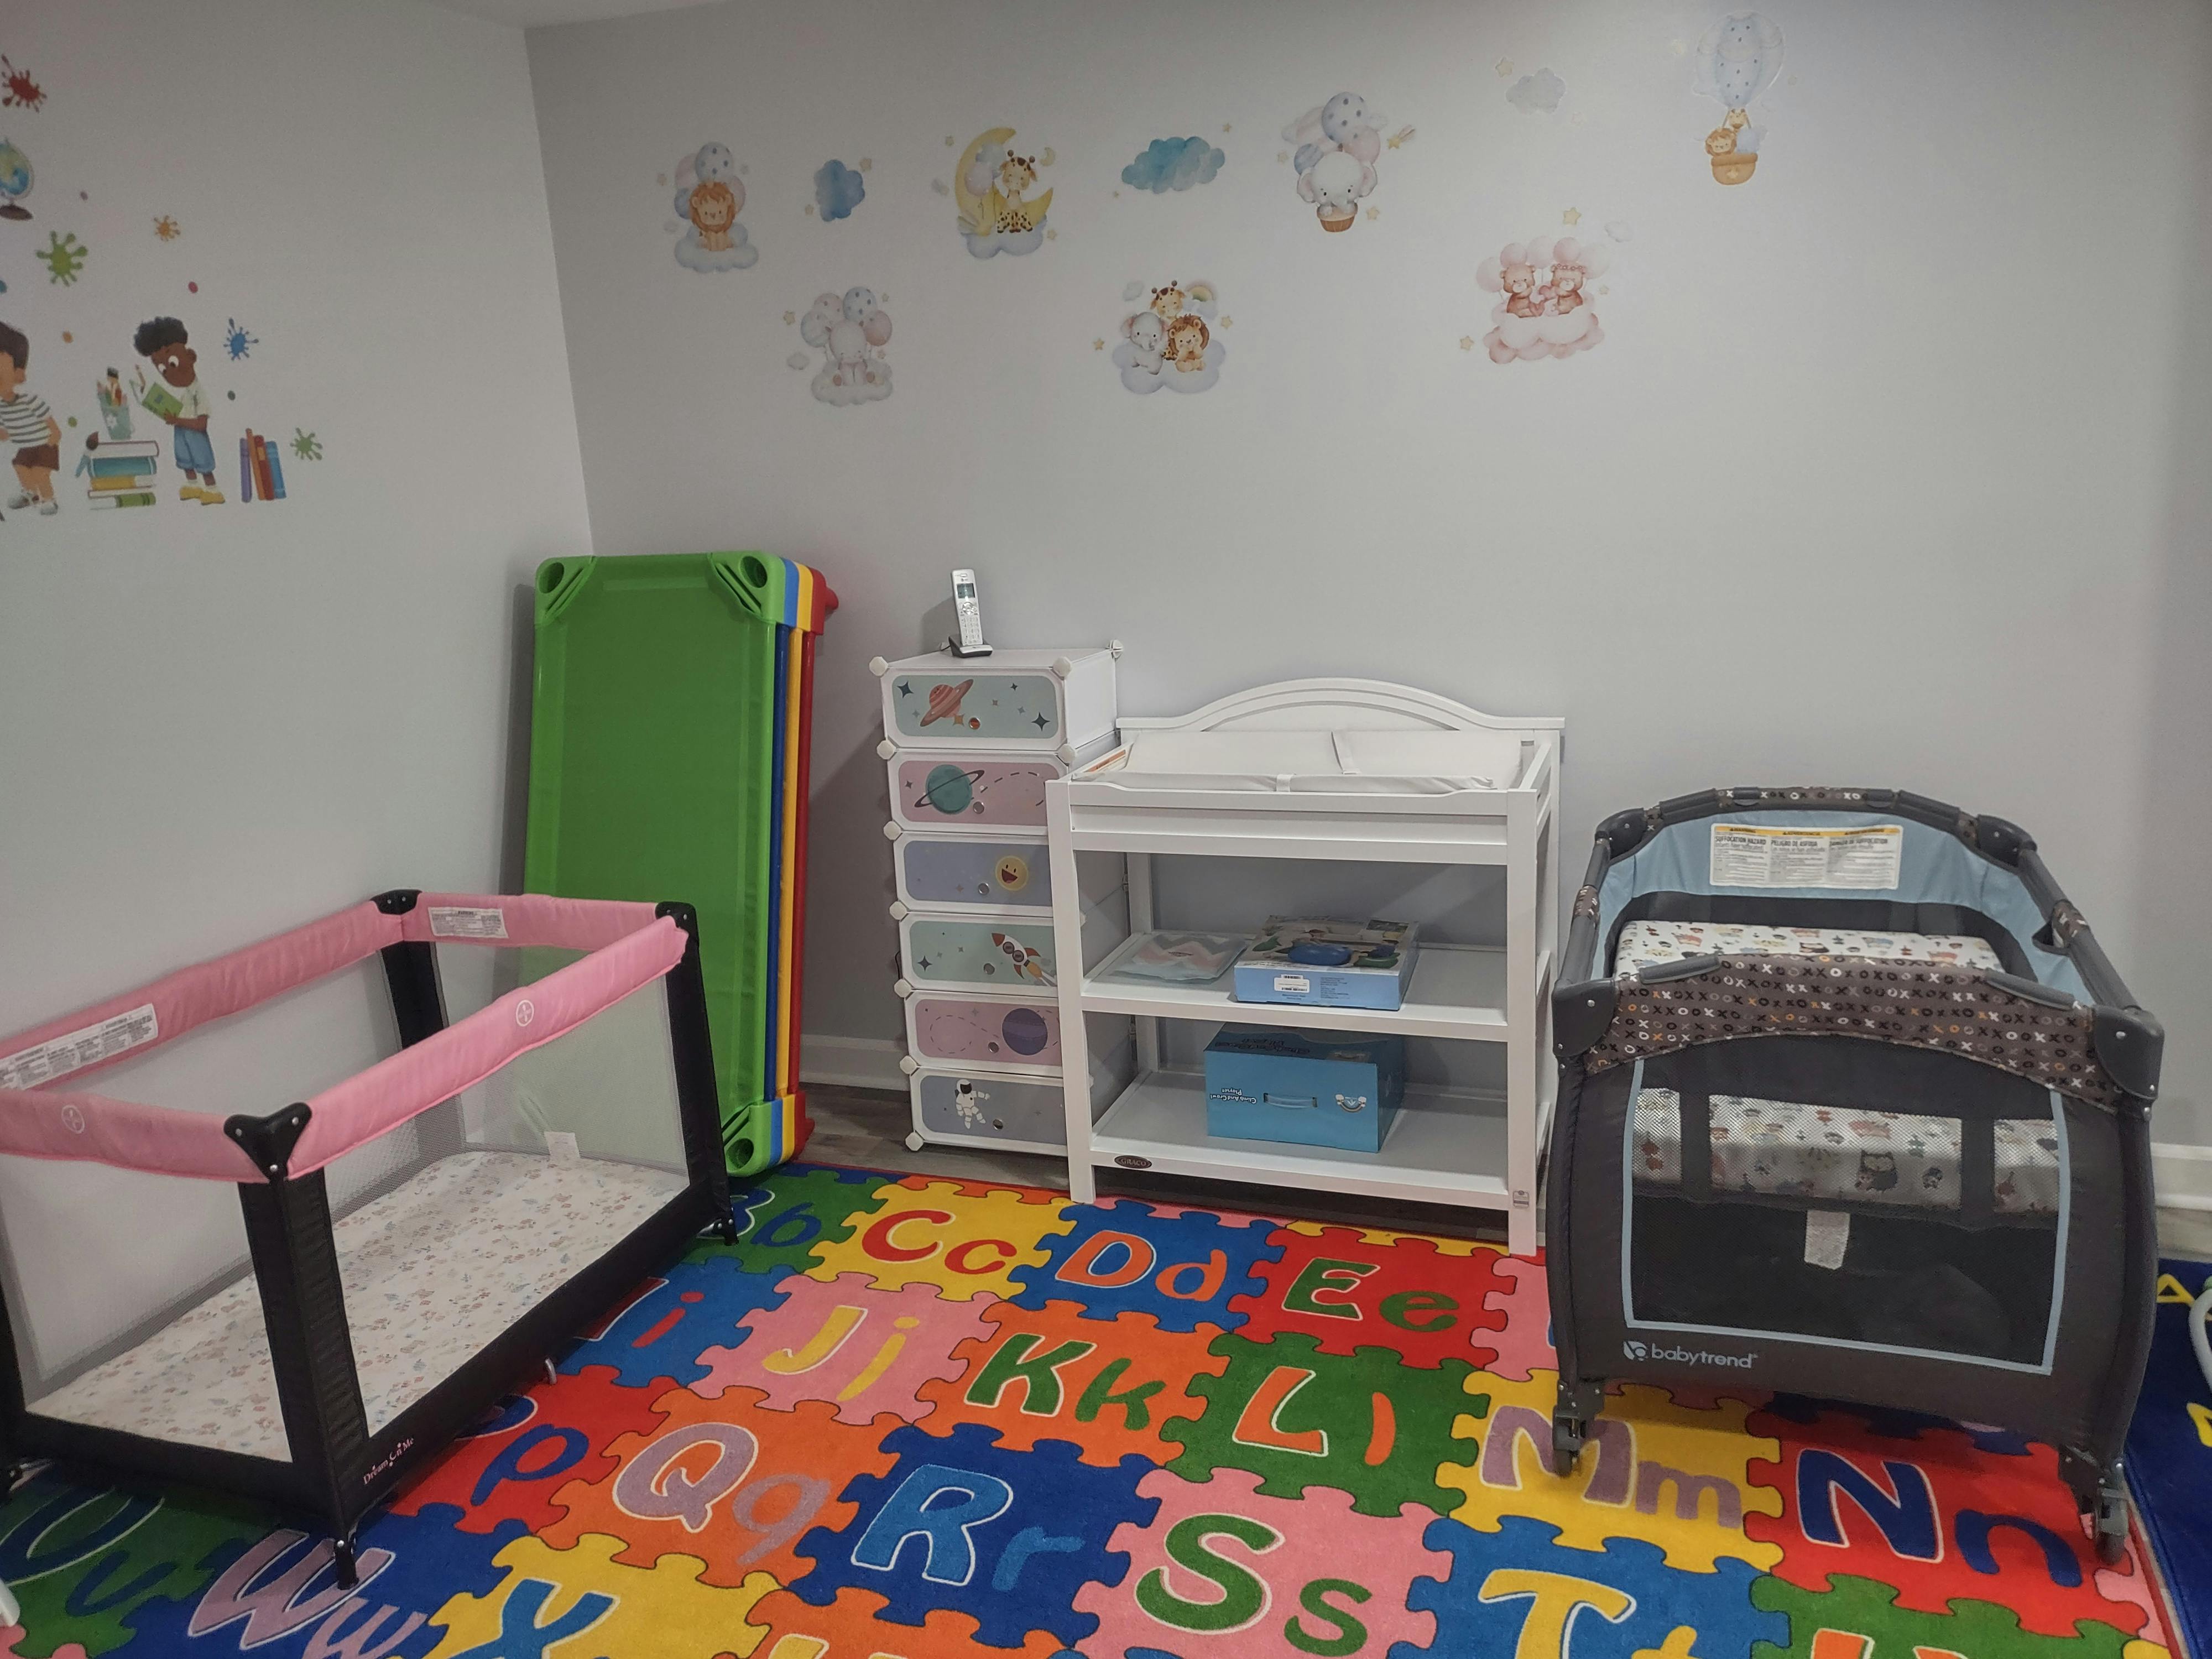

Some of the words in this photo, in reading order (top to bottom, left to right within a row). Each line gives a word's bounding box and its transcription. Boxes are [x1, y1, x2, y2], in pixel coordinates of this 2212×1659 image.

[1222, 1087, 1243, 1096] Playset
[1239, 1096, 1257, 1104] Climb
[1651, 1343, 1752, 1369] babytrend
[363, 1460, 388, 1484] Dream
